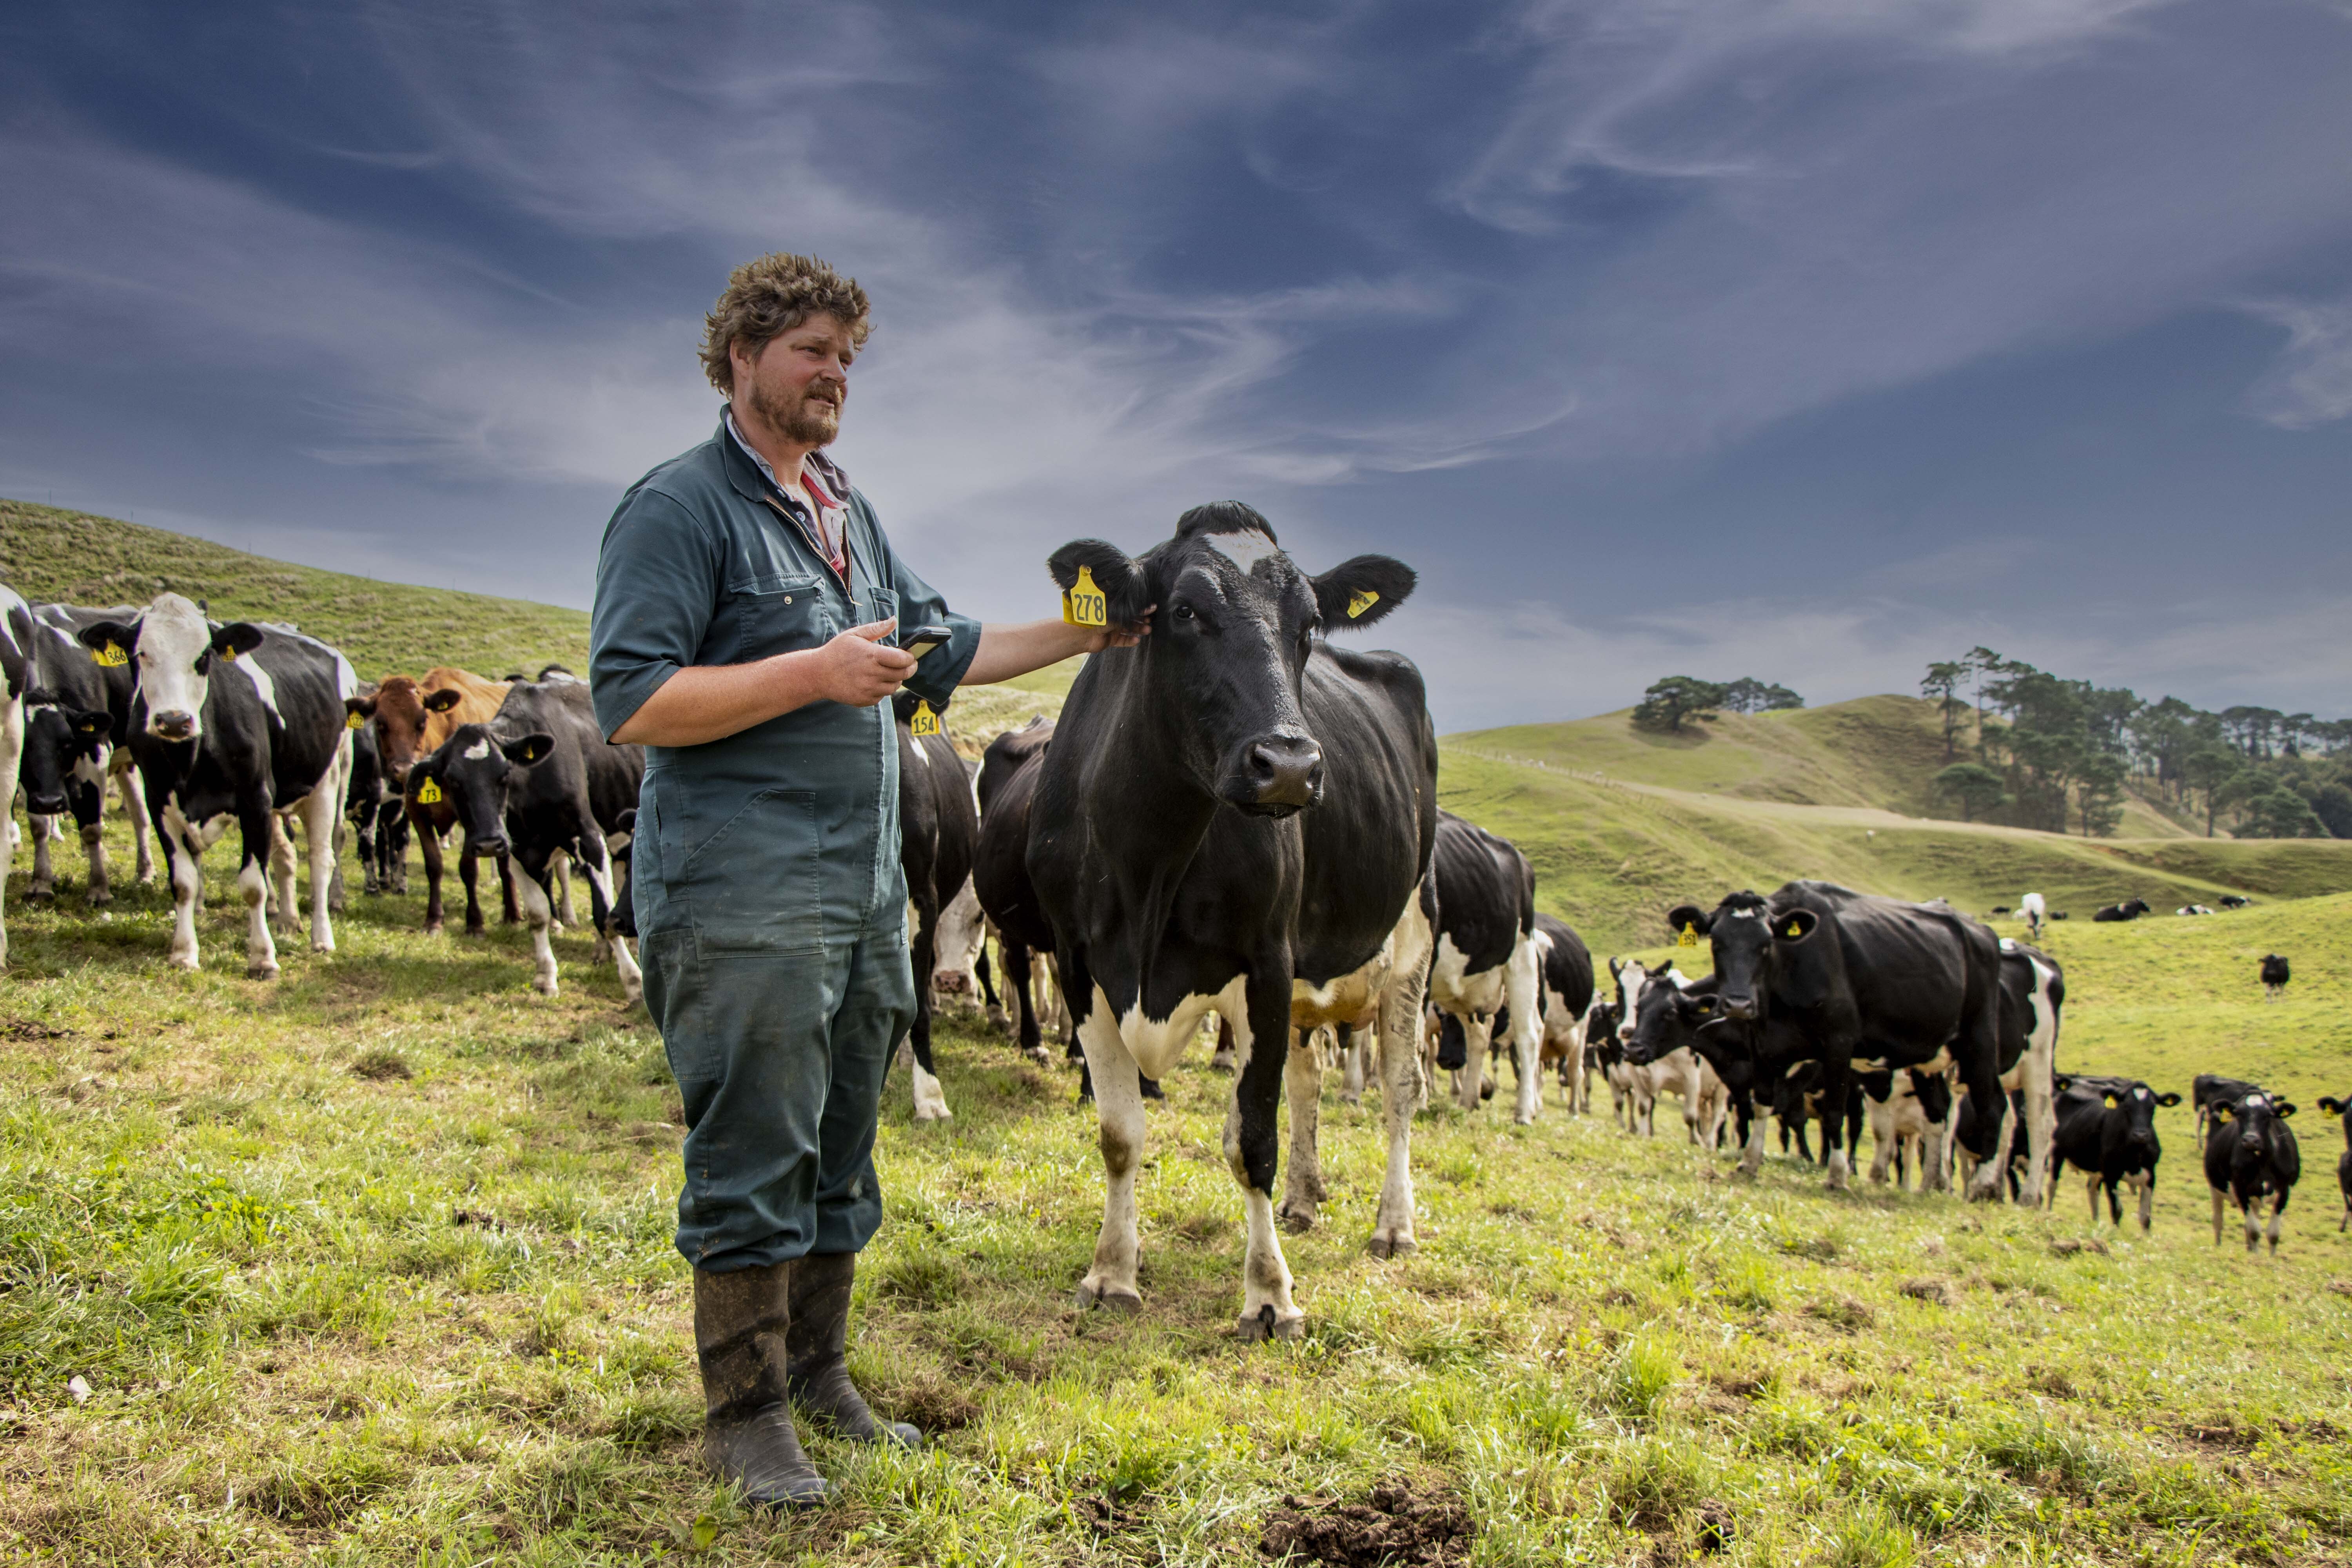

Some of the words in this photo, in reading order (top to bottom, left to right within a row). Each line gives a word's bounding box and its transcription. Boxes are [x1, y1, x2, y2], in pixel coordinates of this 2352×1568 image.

[1074, 593, 1104, 622] 278
[107, 650, 125, 663] 366
[914, 716, 935, 733] 154
[426, 789, 437, 802] 73
